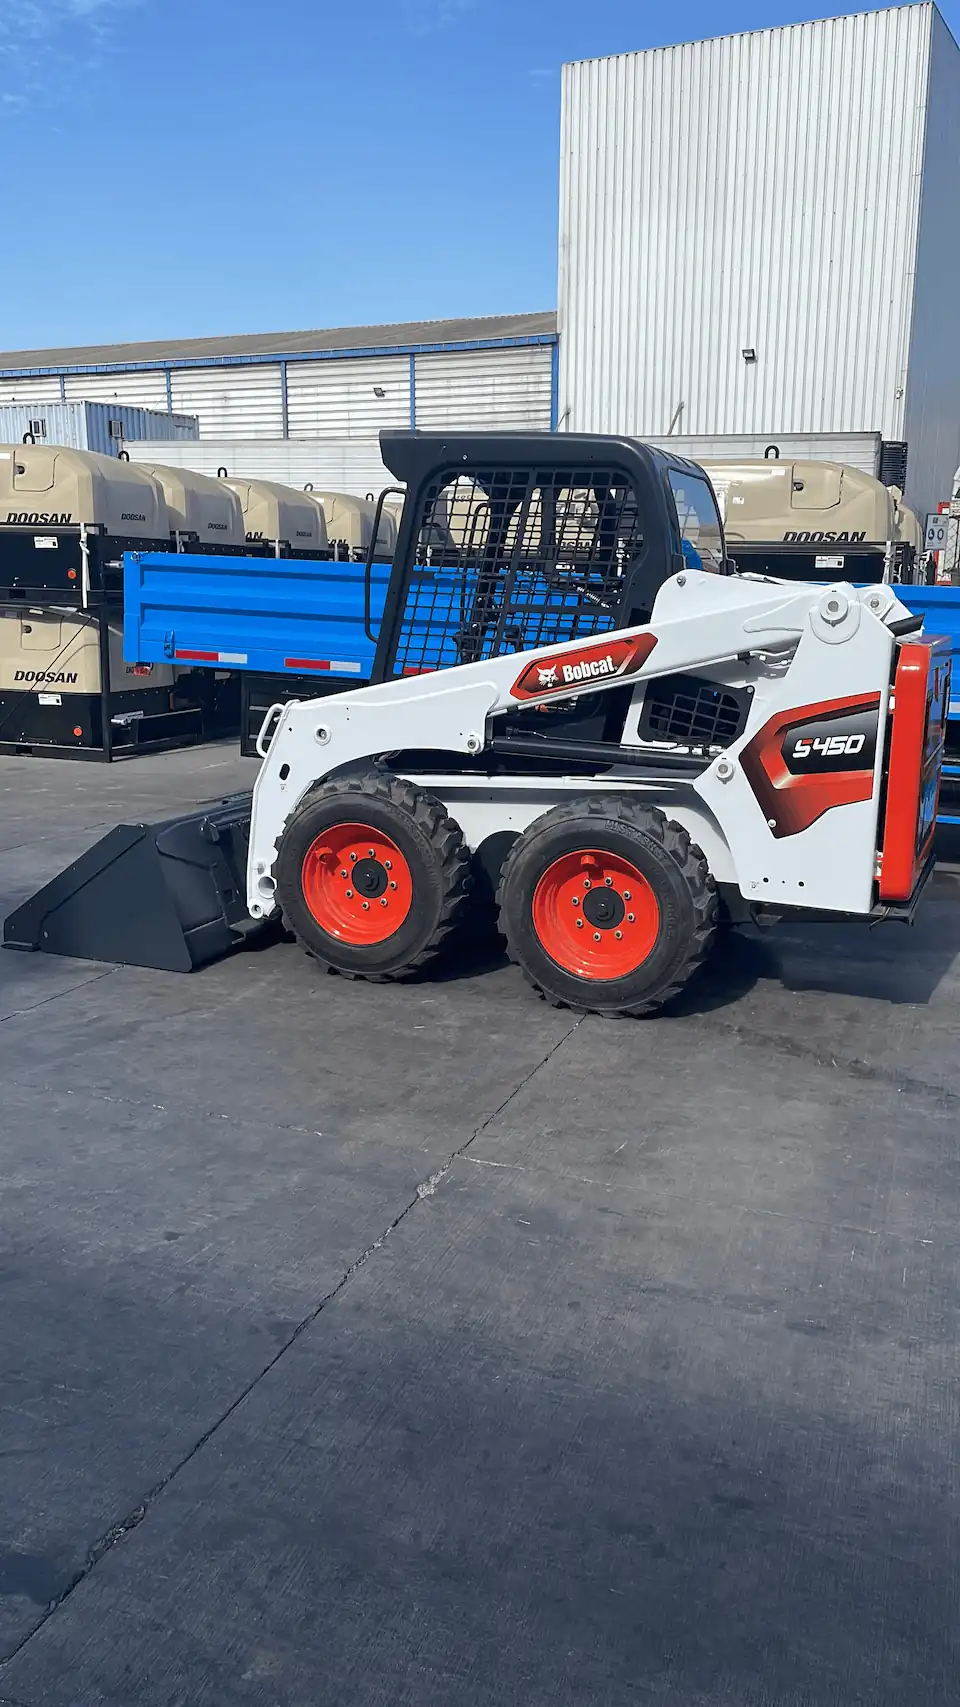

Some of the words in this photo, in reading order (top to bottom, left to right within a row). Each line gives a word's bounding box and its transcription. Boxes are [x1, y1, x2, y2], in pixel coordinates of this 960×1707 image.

[6, 512, 72, 523] DOOSAN
[121, 513, 146, 522] DOOSAN
[782, 531, 866, 543] DOOSAN
[562, 655, 615, 683] Bobcat
[14, 670, 78, 684] DOOSAN
[792, 734, 866, 758] S450
